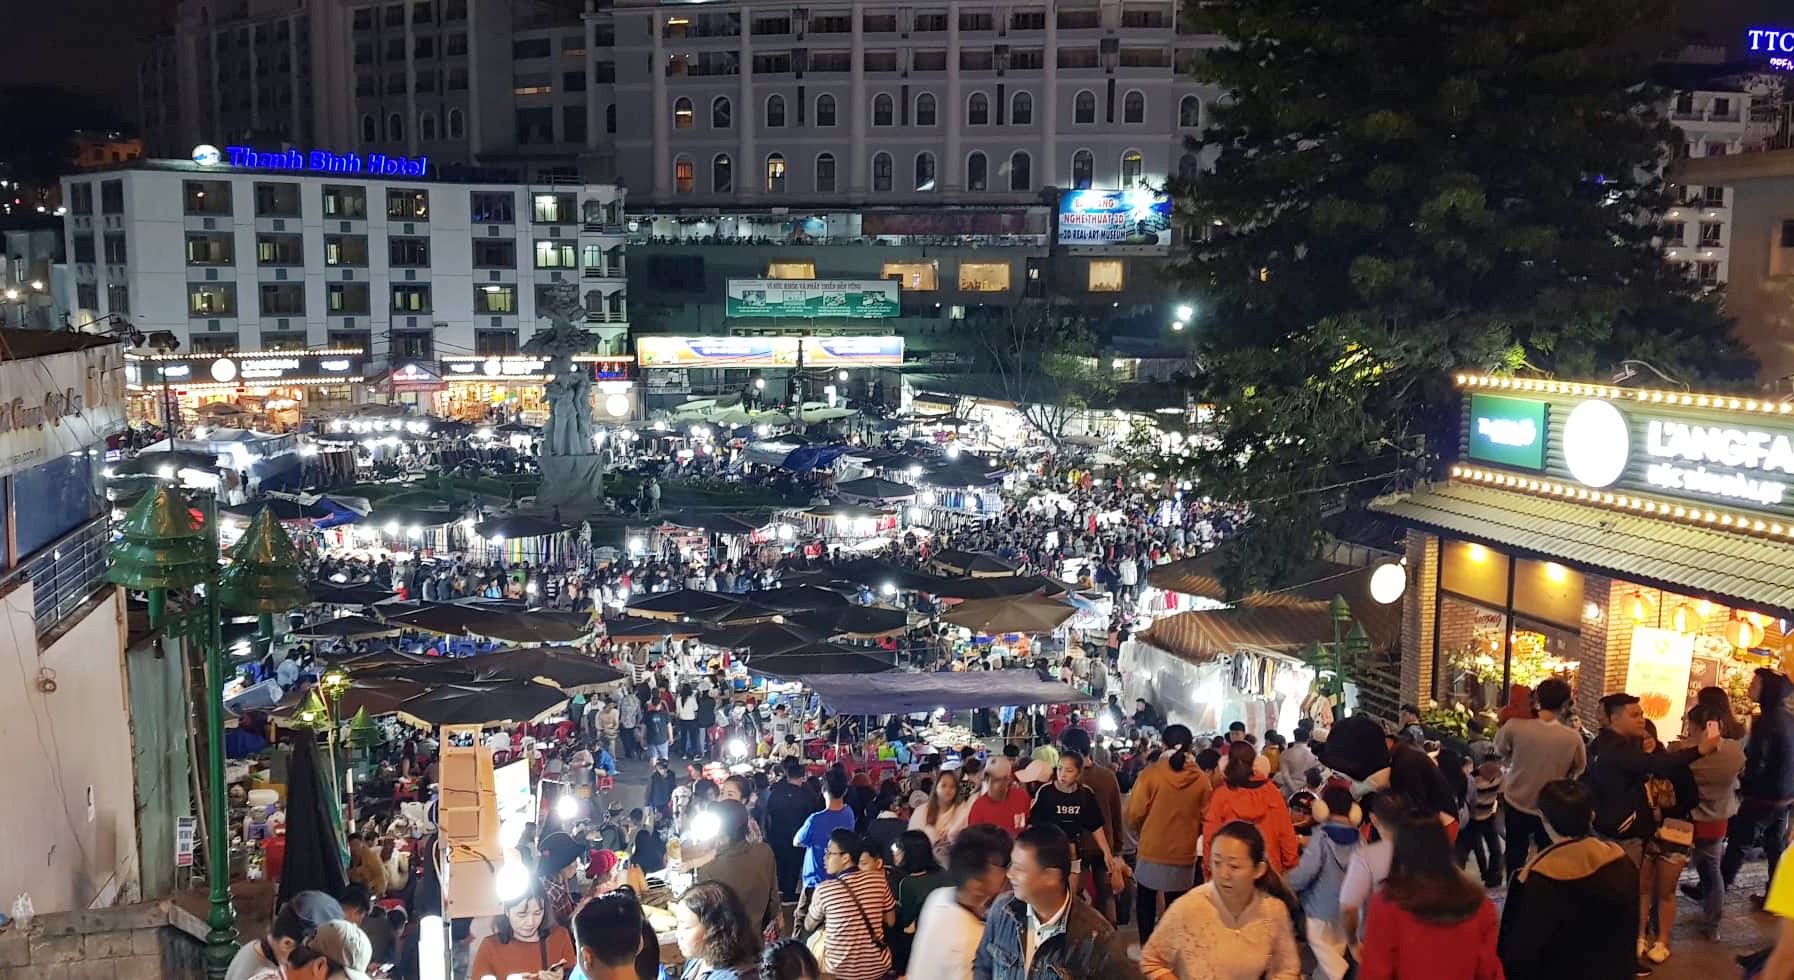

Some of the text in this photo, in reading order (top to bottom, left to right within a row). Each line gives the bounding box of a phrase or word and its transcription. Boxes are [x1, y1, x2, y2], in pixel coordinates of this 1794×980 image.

[1748, 30, 1794, 52] TTC
[226, 147, 304, 169] Thanh
[369, 153, 427, 176] Hotel
[1073, 229, 1086, 240] REAL
[1088, 229, 1099, 240] ART
[1100, 230, 1126, 240] MUSEUM
[1056, 805, 1081, 814] 1987
